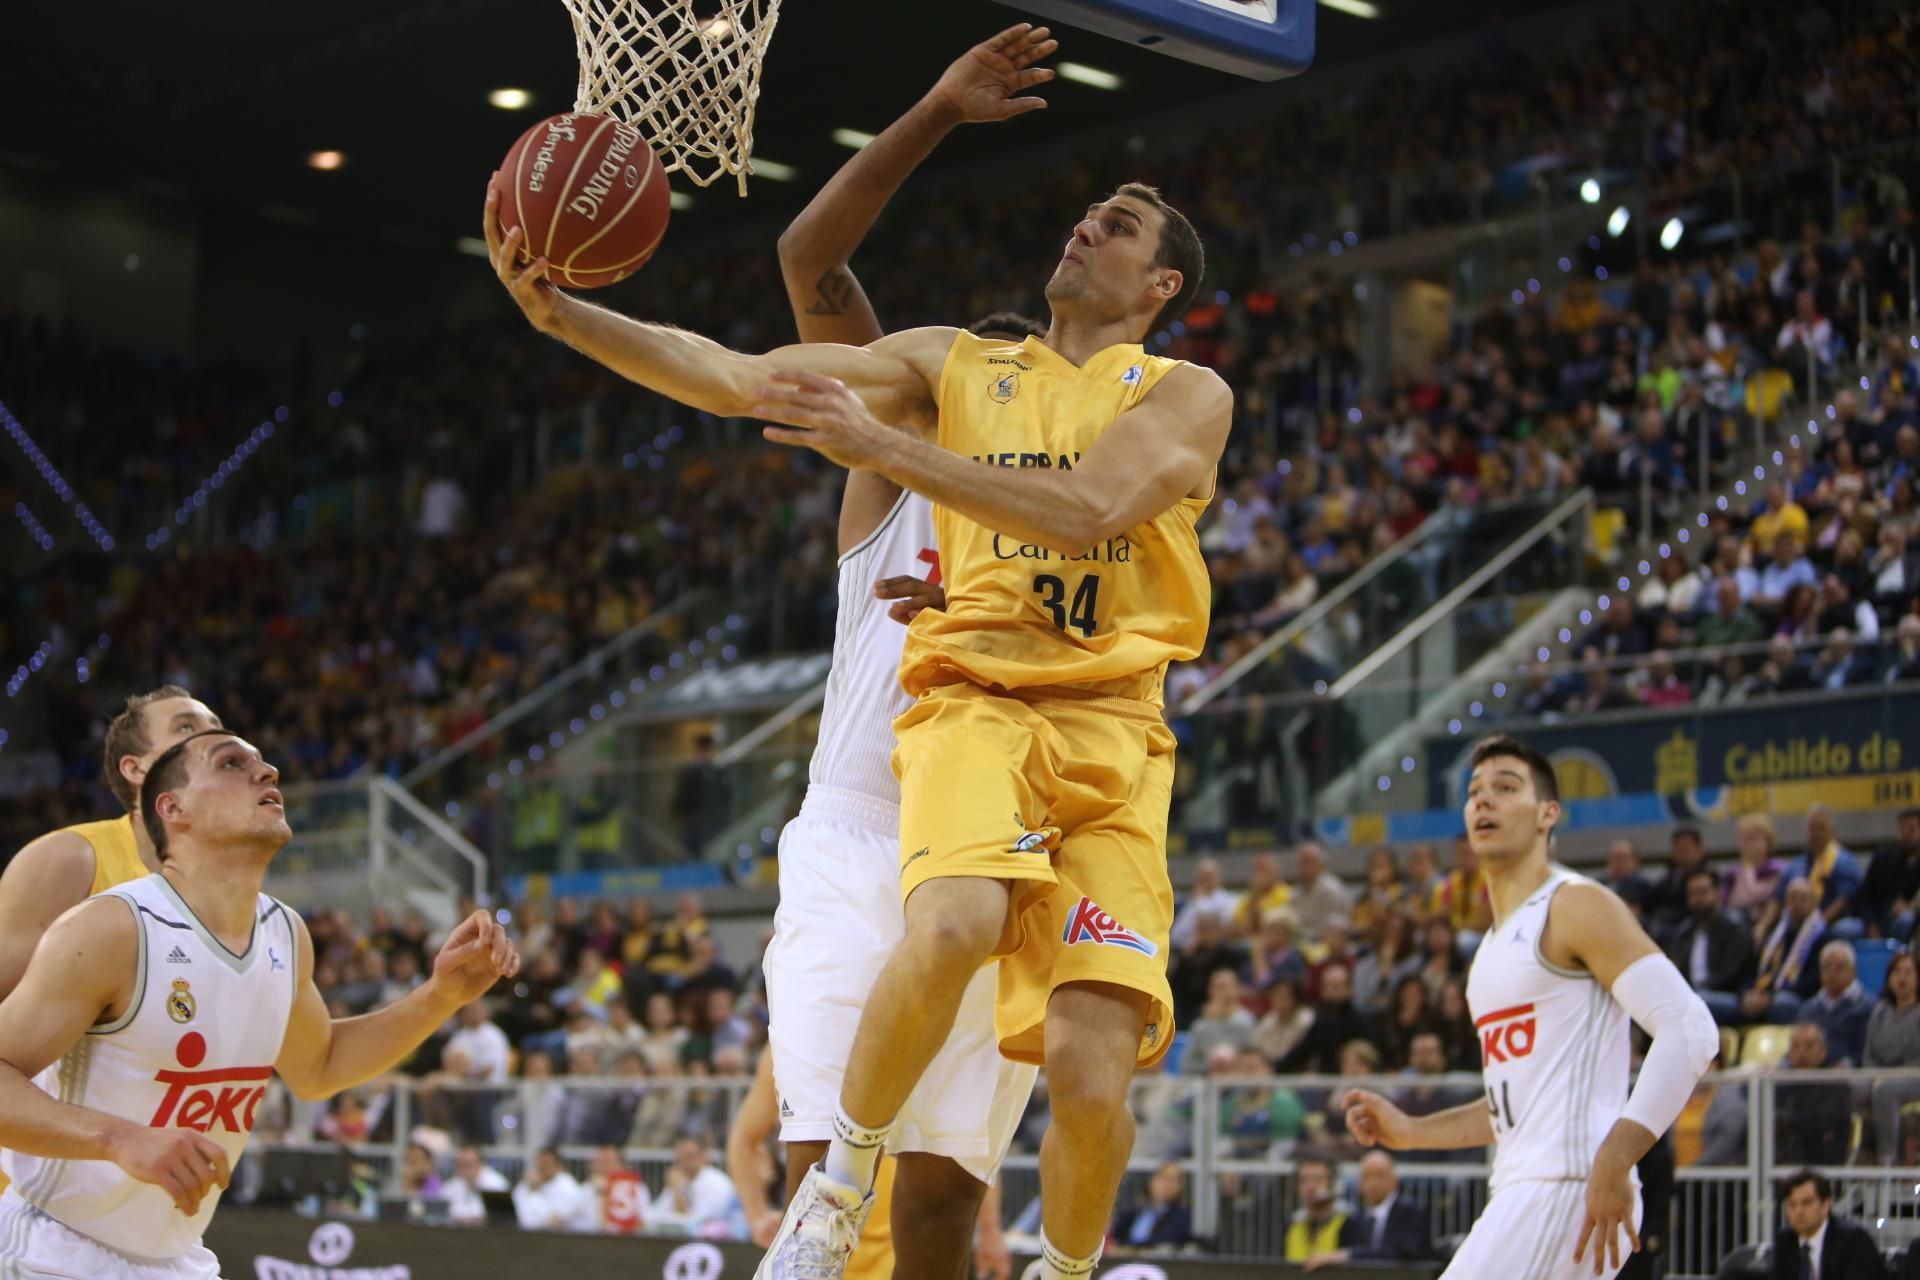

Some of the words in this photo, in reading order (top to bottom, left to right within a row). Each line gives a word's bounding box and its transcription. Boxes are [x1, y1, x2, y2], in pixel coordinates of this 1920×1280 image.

[992, 532, 1131, 564] Caia
[1033, 573, 1100, 639] 34
[1725, 735, 1851, 782] Cabildo
[1857, 731, 1902, 771] de
